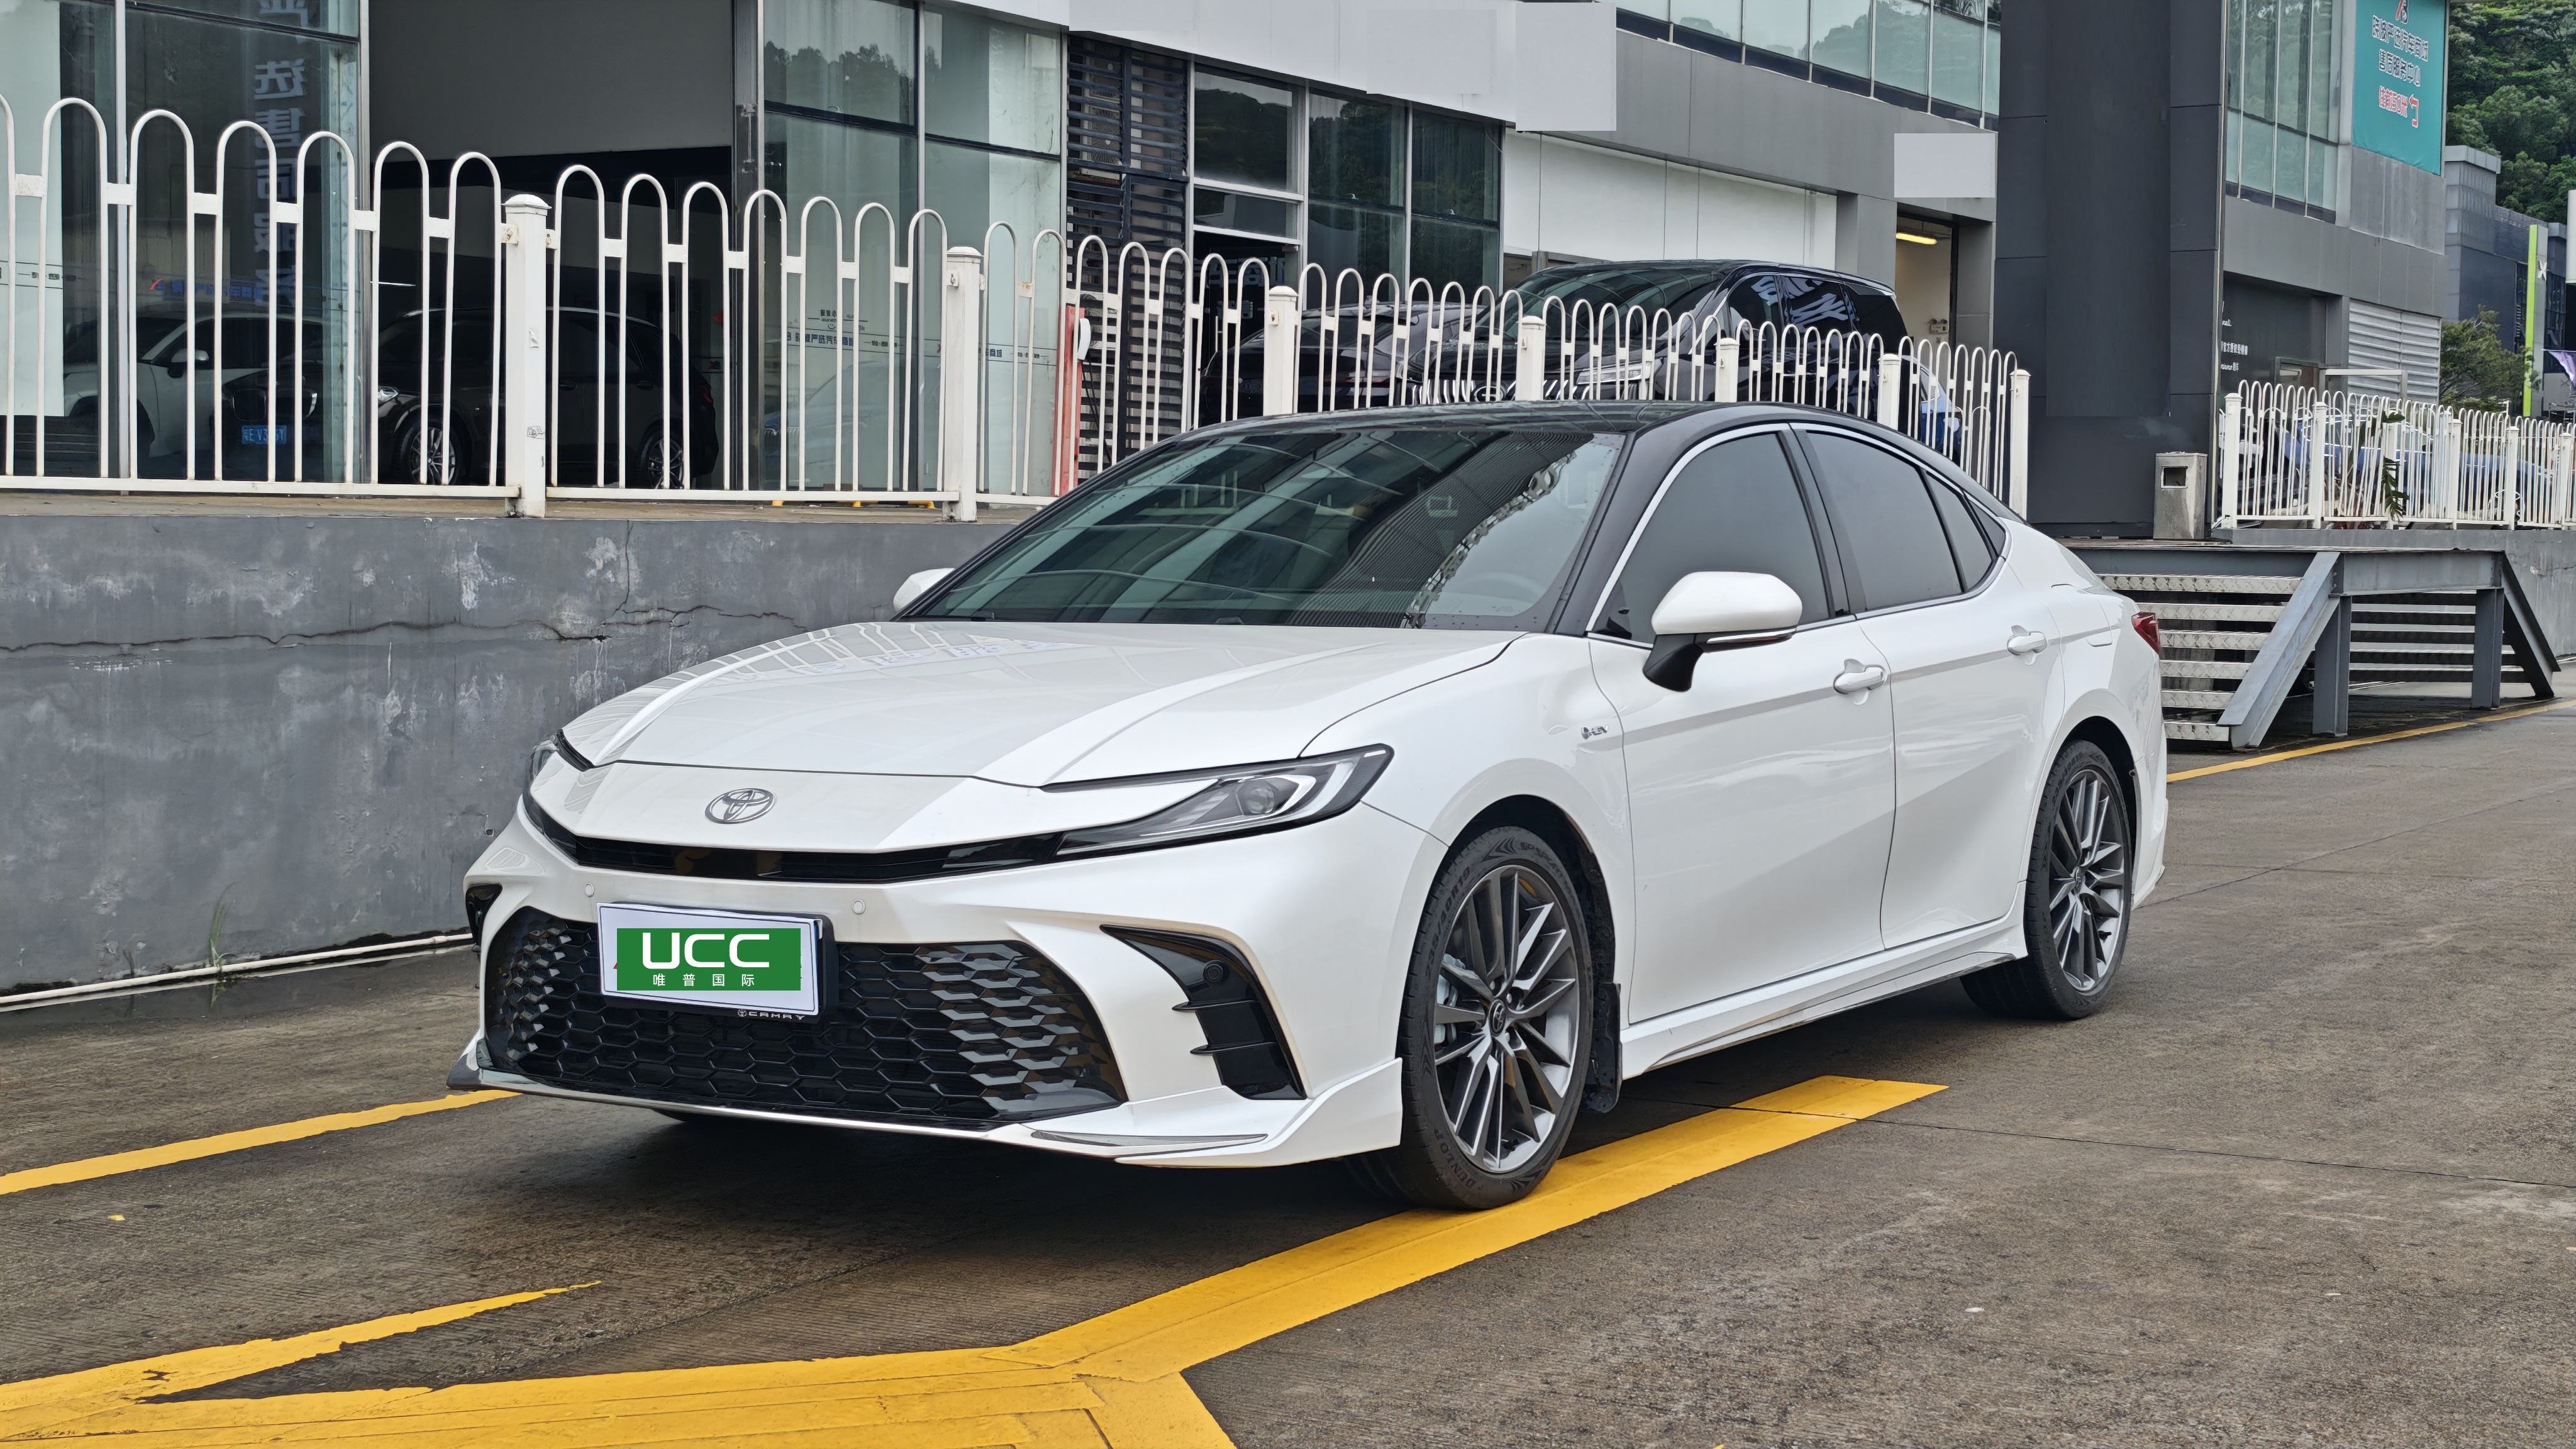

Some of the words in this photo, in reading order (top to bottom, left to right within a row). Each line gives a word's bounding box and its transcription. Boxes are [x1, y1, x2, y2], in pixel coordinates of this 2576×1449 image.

[2379, 48, 2421, 87] 售后服务中心
[748, 1011, 806, 1021] CAMRY
[1432, 1124, 1478, 1191] DUNLOP
